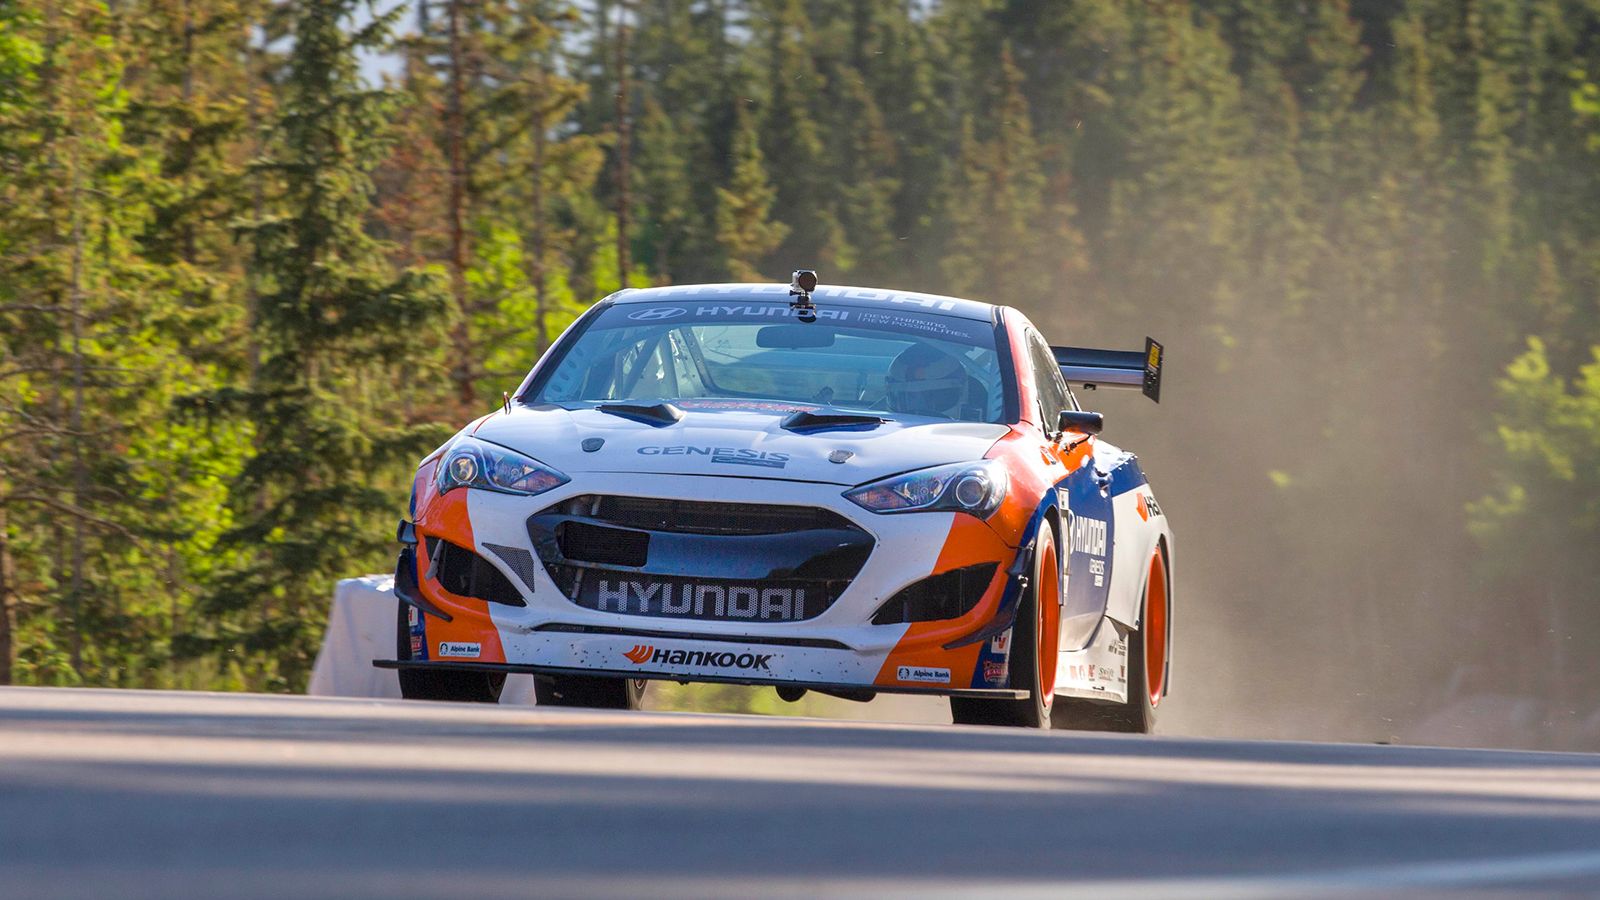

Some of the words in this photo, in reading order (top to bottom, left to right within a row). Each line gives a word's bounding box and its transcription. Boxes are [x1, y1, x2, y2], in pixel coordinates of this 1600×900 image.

[696, 306, 848, 321] HYUNDAI
[636, 446, 790, 462] GENESIS
[1075, 515, 1107, 557] HYUNDAI
[598, 580, 805, 620] HYUNDAI
[913, 669, 933, 678] Alpine
